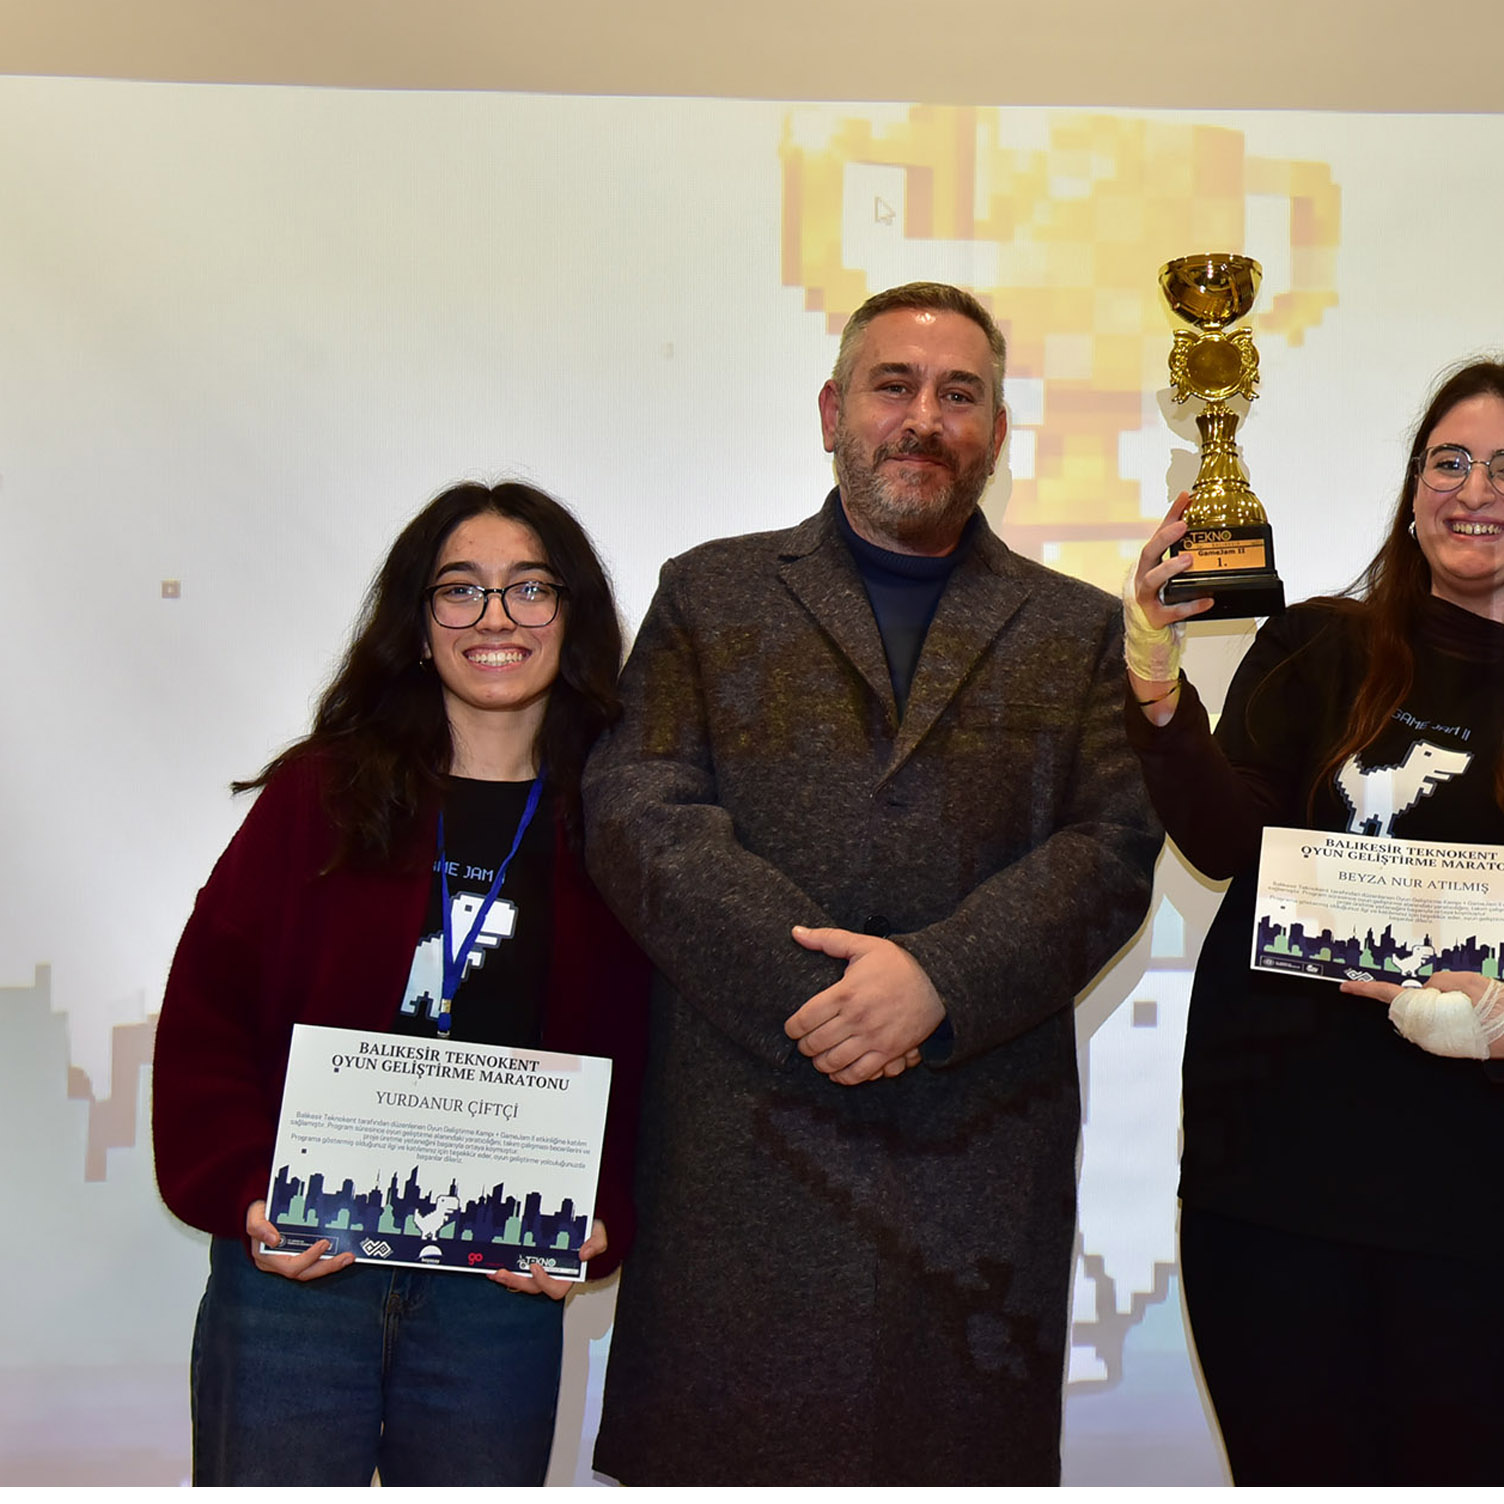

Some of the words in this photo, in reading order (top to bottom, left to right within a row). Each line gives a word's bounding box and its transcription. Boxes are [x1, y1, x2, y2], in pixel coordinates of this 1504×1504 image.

[1190, 530, 1232, 542] TEKNO
[1198, 549, 1235, 557] GameJam
[1218, 557, 1228, 567] 1.
[1300, 846, 1343, 858] OYUN
[1347, 851, 1436, 866] GELİŞTİRME
[1325, 839, 1401, 854] BALIKESİR
[1406, 846, 1497, 861] TEKNOKENT
[463, 864, 494, 883] JAM
[1338, 871, 1386, 884] BEYZA
[1391, 876, 1422, 888] NUR
[1428, 879, 1489, 894] ATILMIŞ
[358, 1041, 440, 1061] BALIKESİR
[445, 1051, 539, 1072] TEKNOKENT
[330, 1054, 377, 1070] OYUN
[381, 1060, 475, 1081] GELİŞTİRME
[478, 1070, 570, 1091] MARATONU
[375, 1091, 463, 1112] YURDANUR
[466, 1099, 519, 1120] ÇİFTÇİ
